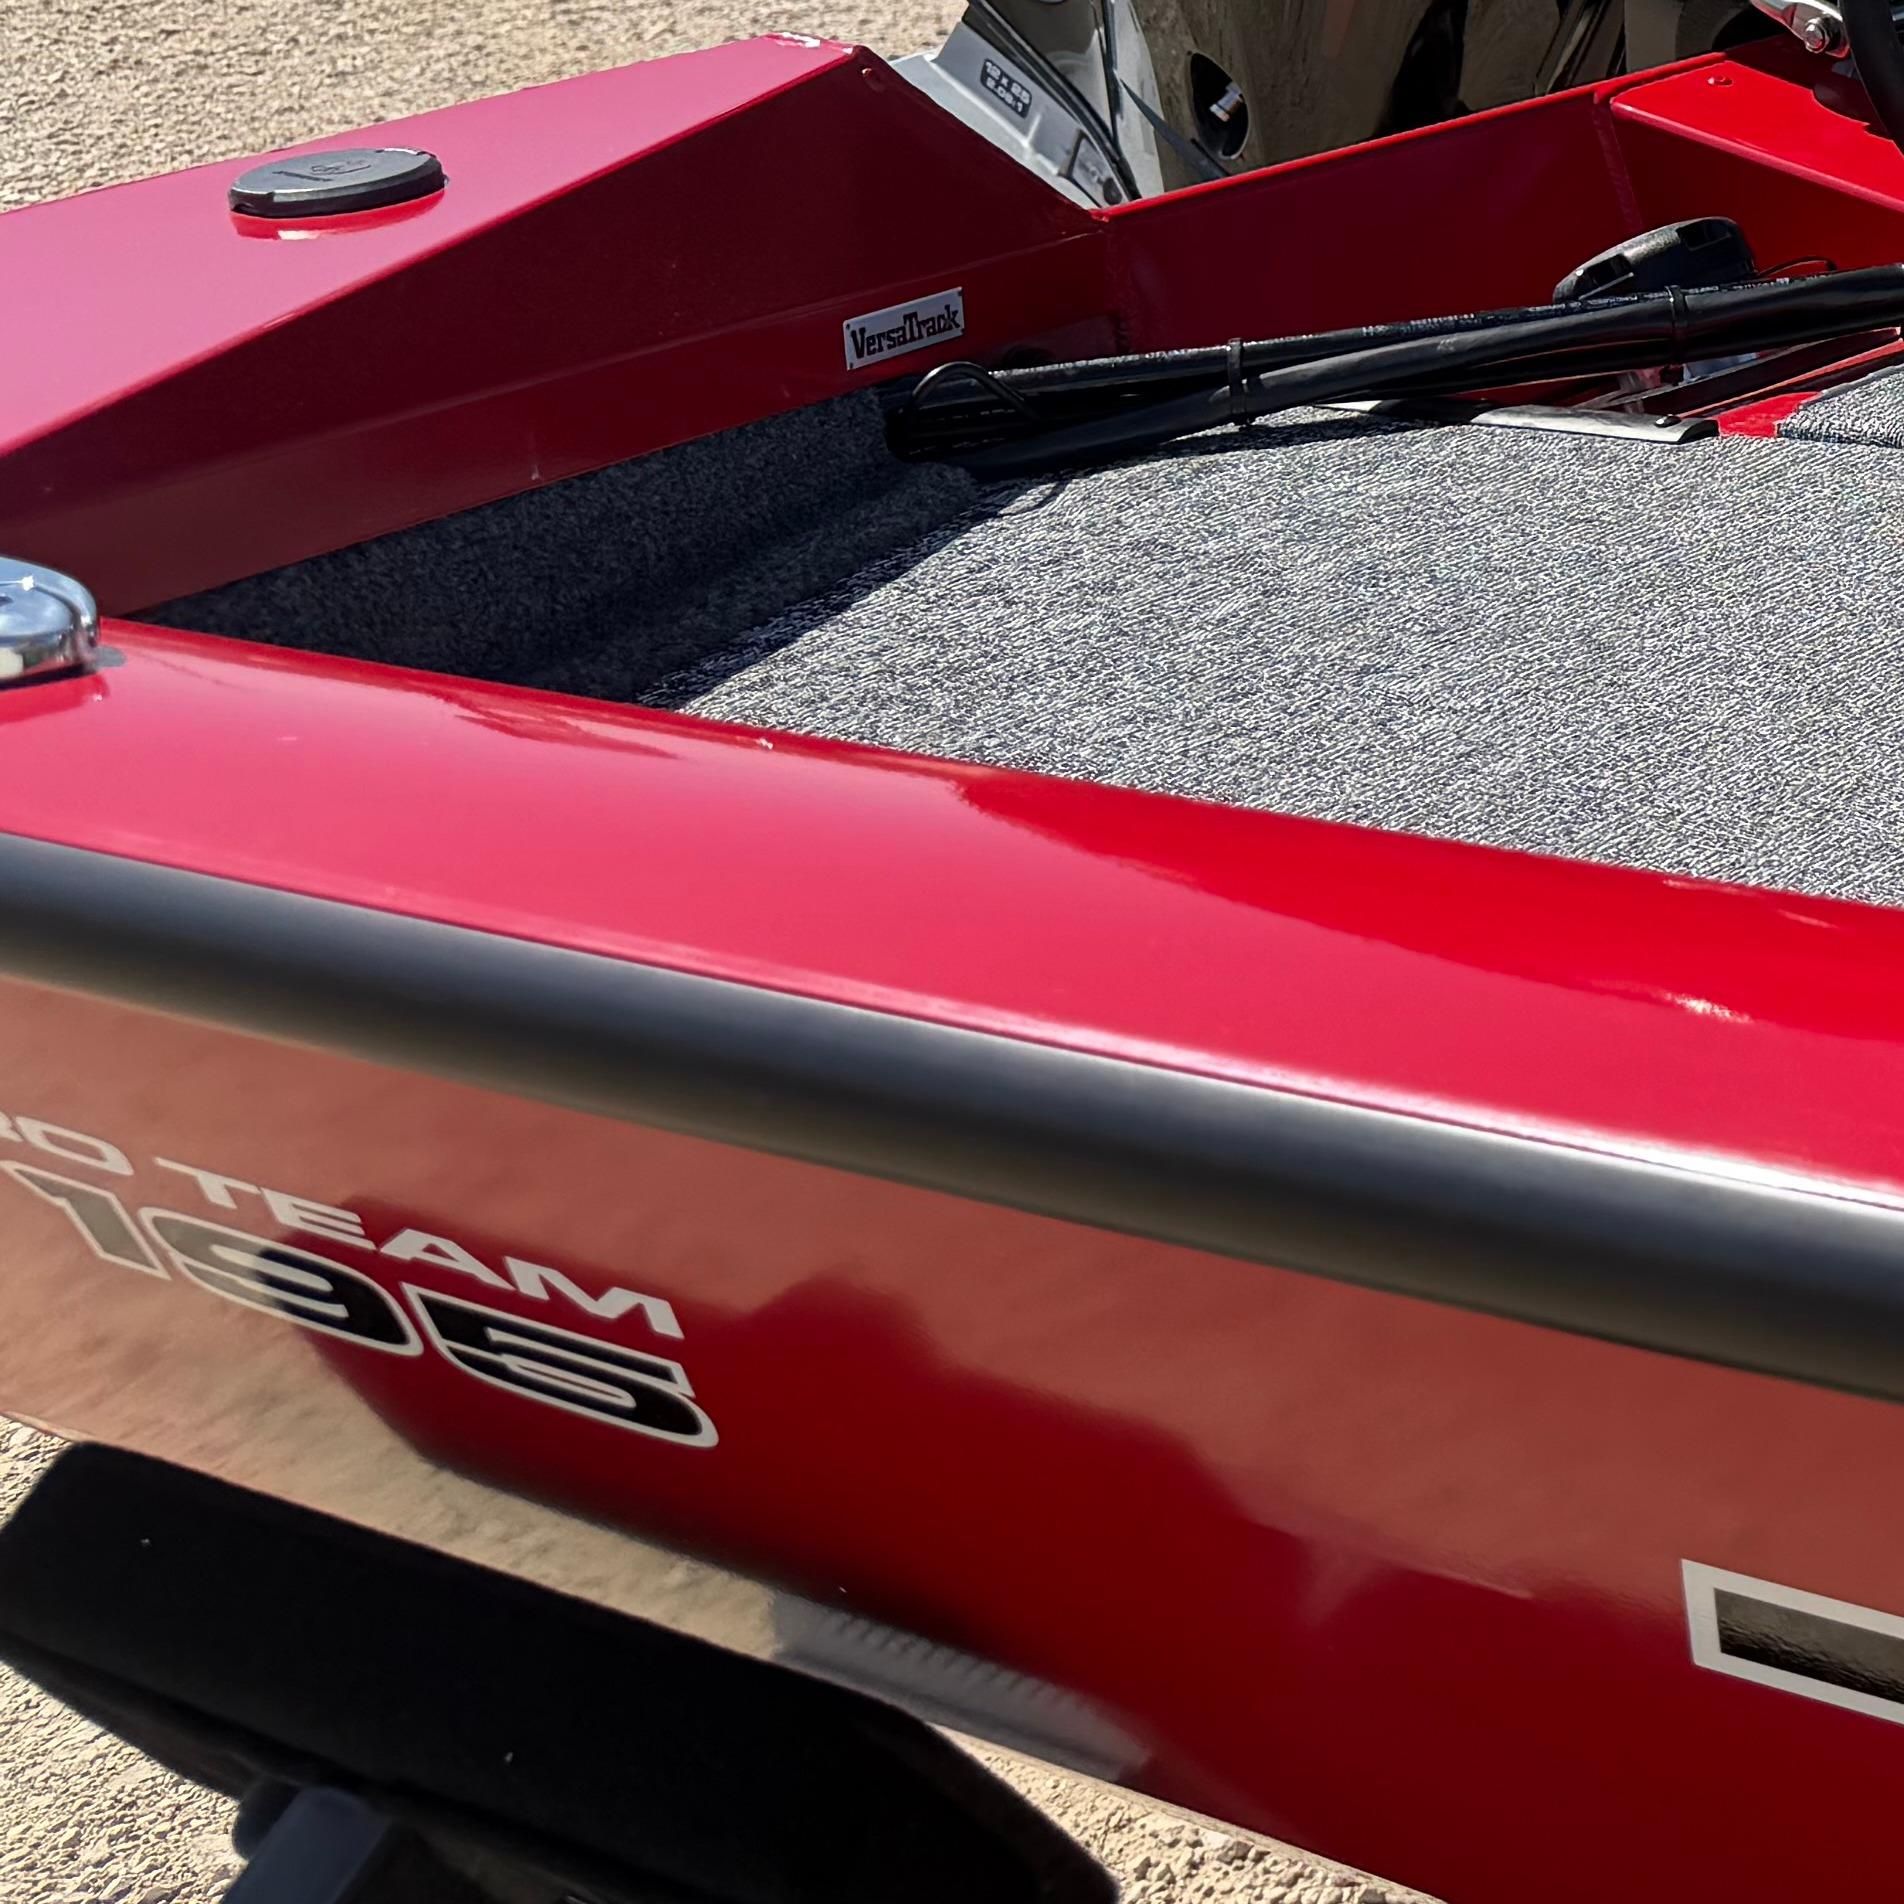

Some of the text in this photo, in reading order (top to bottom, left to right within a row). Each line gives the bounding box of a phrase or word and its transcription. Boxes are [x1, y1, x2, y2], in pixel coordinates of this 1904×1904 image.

[850, 304, 961, 359] VersaTrack
[0, 1160, 719, 1448] 195
[154, 1156, 685, 1340] TEAM
